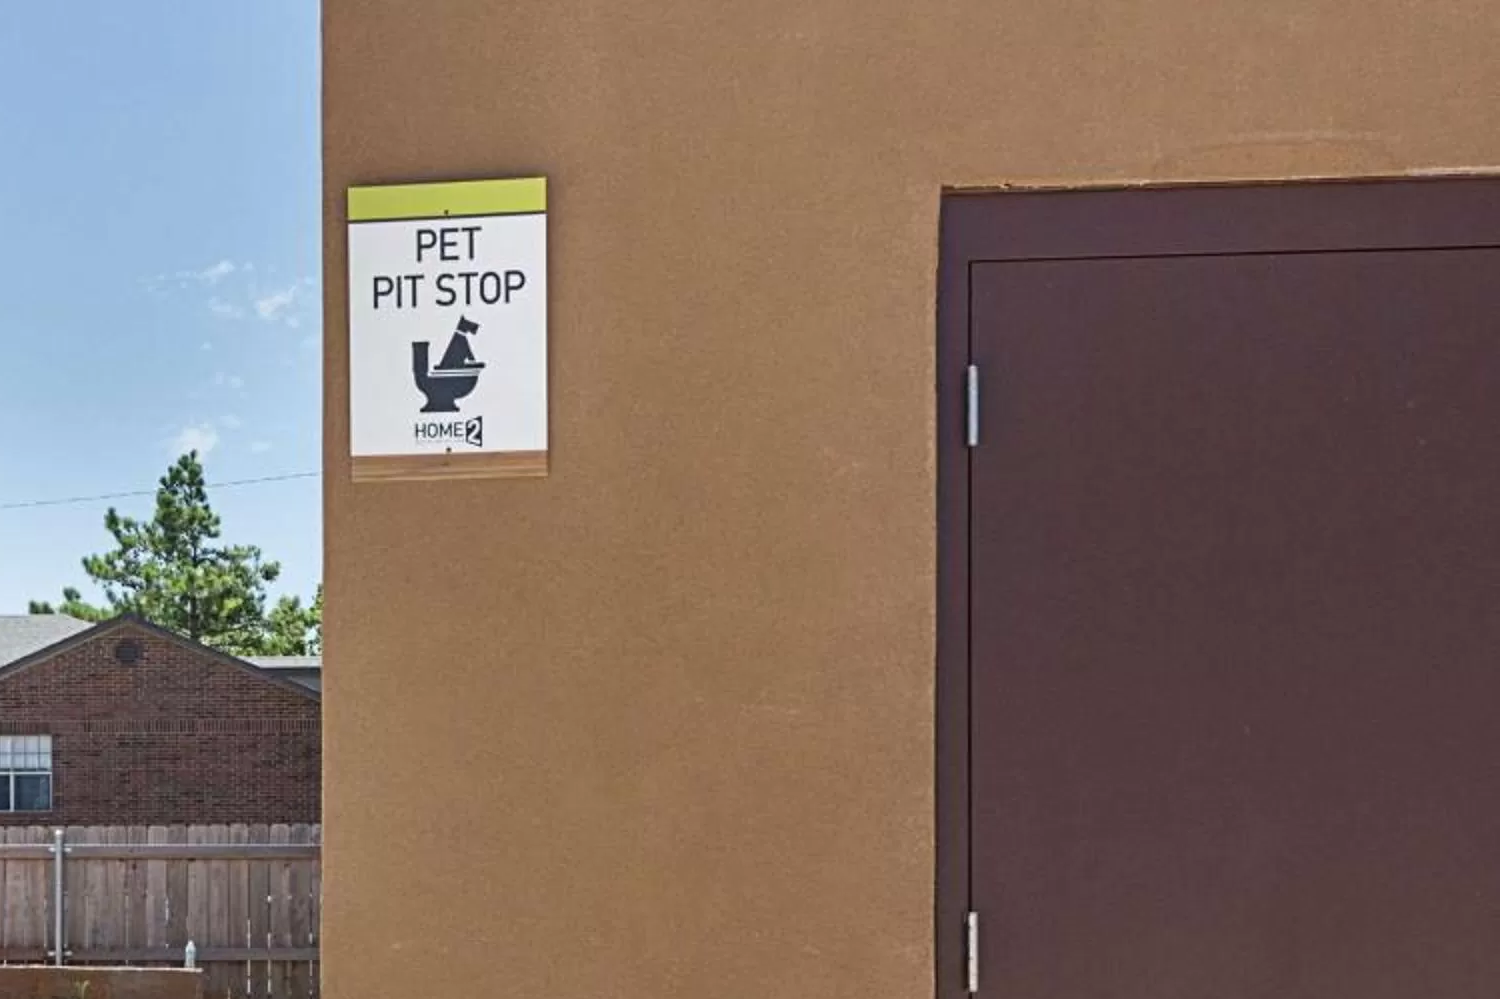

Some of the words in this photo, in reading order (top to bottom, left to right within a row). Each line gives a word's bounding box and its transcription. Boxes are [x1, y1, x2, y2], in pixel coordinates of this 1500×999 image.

[416, 226, 482, 262] PET
[372, 274, 424, 309] PIT
[435, 270, 526, 307] STOP
